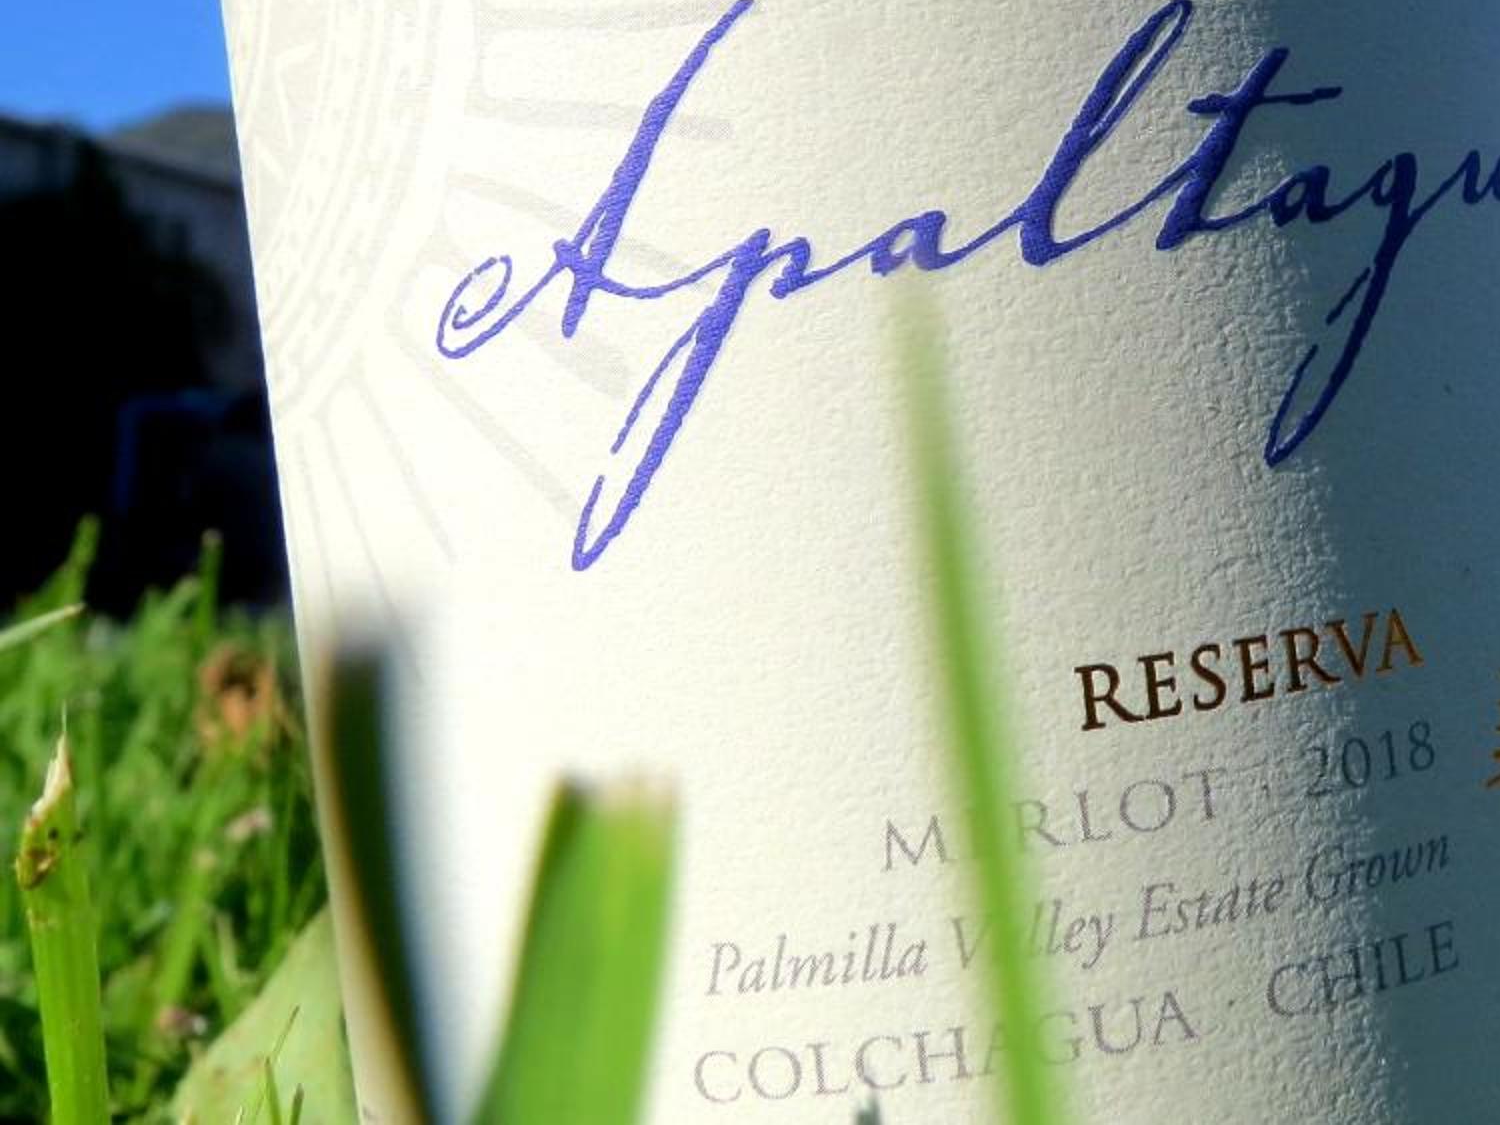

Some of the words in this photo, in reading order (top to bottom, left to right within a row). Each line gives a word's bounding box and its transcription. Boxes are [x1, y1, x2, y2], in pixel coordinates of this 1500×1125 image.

[1073, 607, 1425, 732] RESERVA
[884, 766, 1227, 873] MRLOT
[1304, 719, 1435, 798] 2018
[704, 921, 928, 997] Palmilla
[949, 897, 1116, 971] Vlley
[1132, 880, 1285, 943] Estate
[1303, 834, 1450, 905] Grown
[1265, 919, 1460, 1021] CHILE
